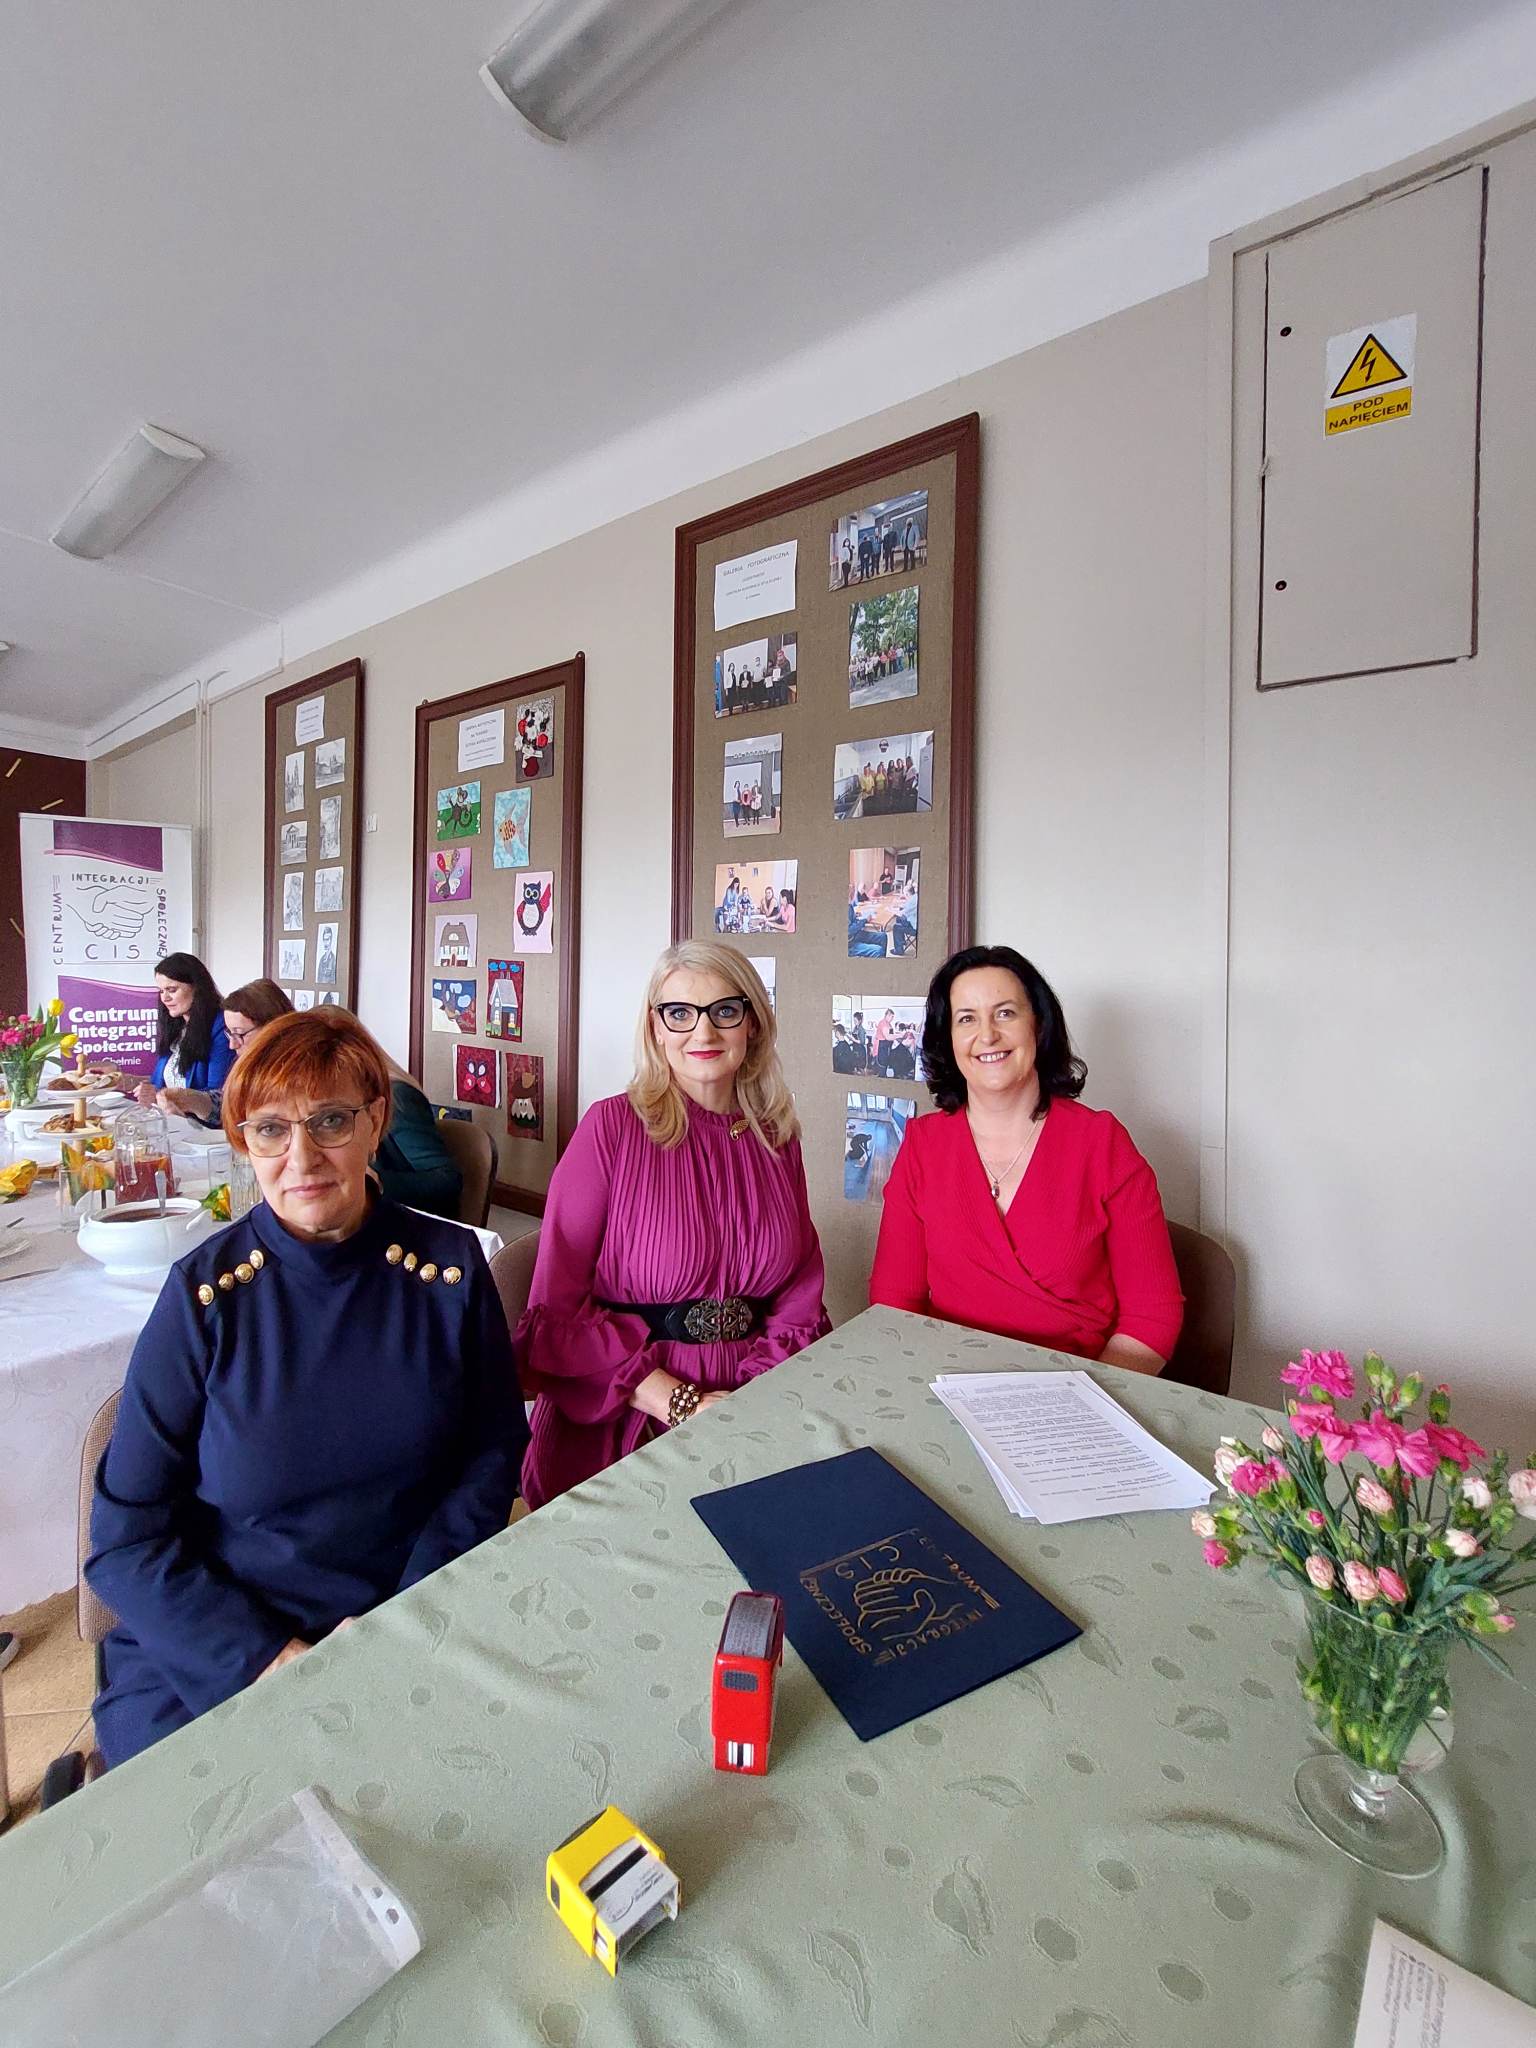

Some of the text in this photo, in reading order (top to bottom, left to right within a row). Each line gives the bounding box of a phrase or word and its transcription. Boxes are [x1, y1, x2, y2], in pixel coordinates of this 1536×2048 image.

[1353, 397, 1384, 412] POD
[1328, 402, 1408, 430] NAPIĘCIEM
[71, 873, 149, 885] INTEGRACJI
[52, 892, 64, 965] CENTRUM
[85, 943, 140, 960] CIS
[68, 1006, 159, 1023] Centrum
[71, 1021, 157, 1041] Integracji
[73, 1038, 156, 1056] Społecznej
